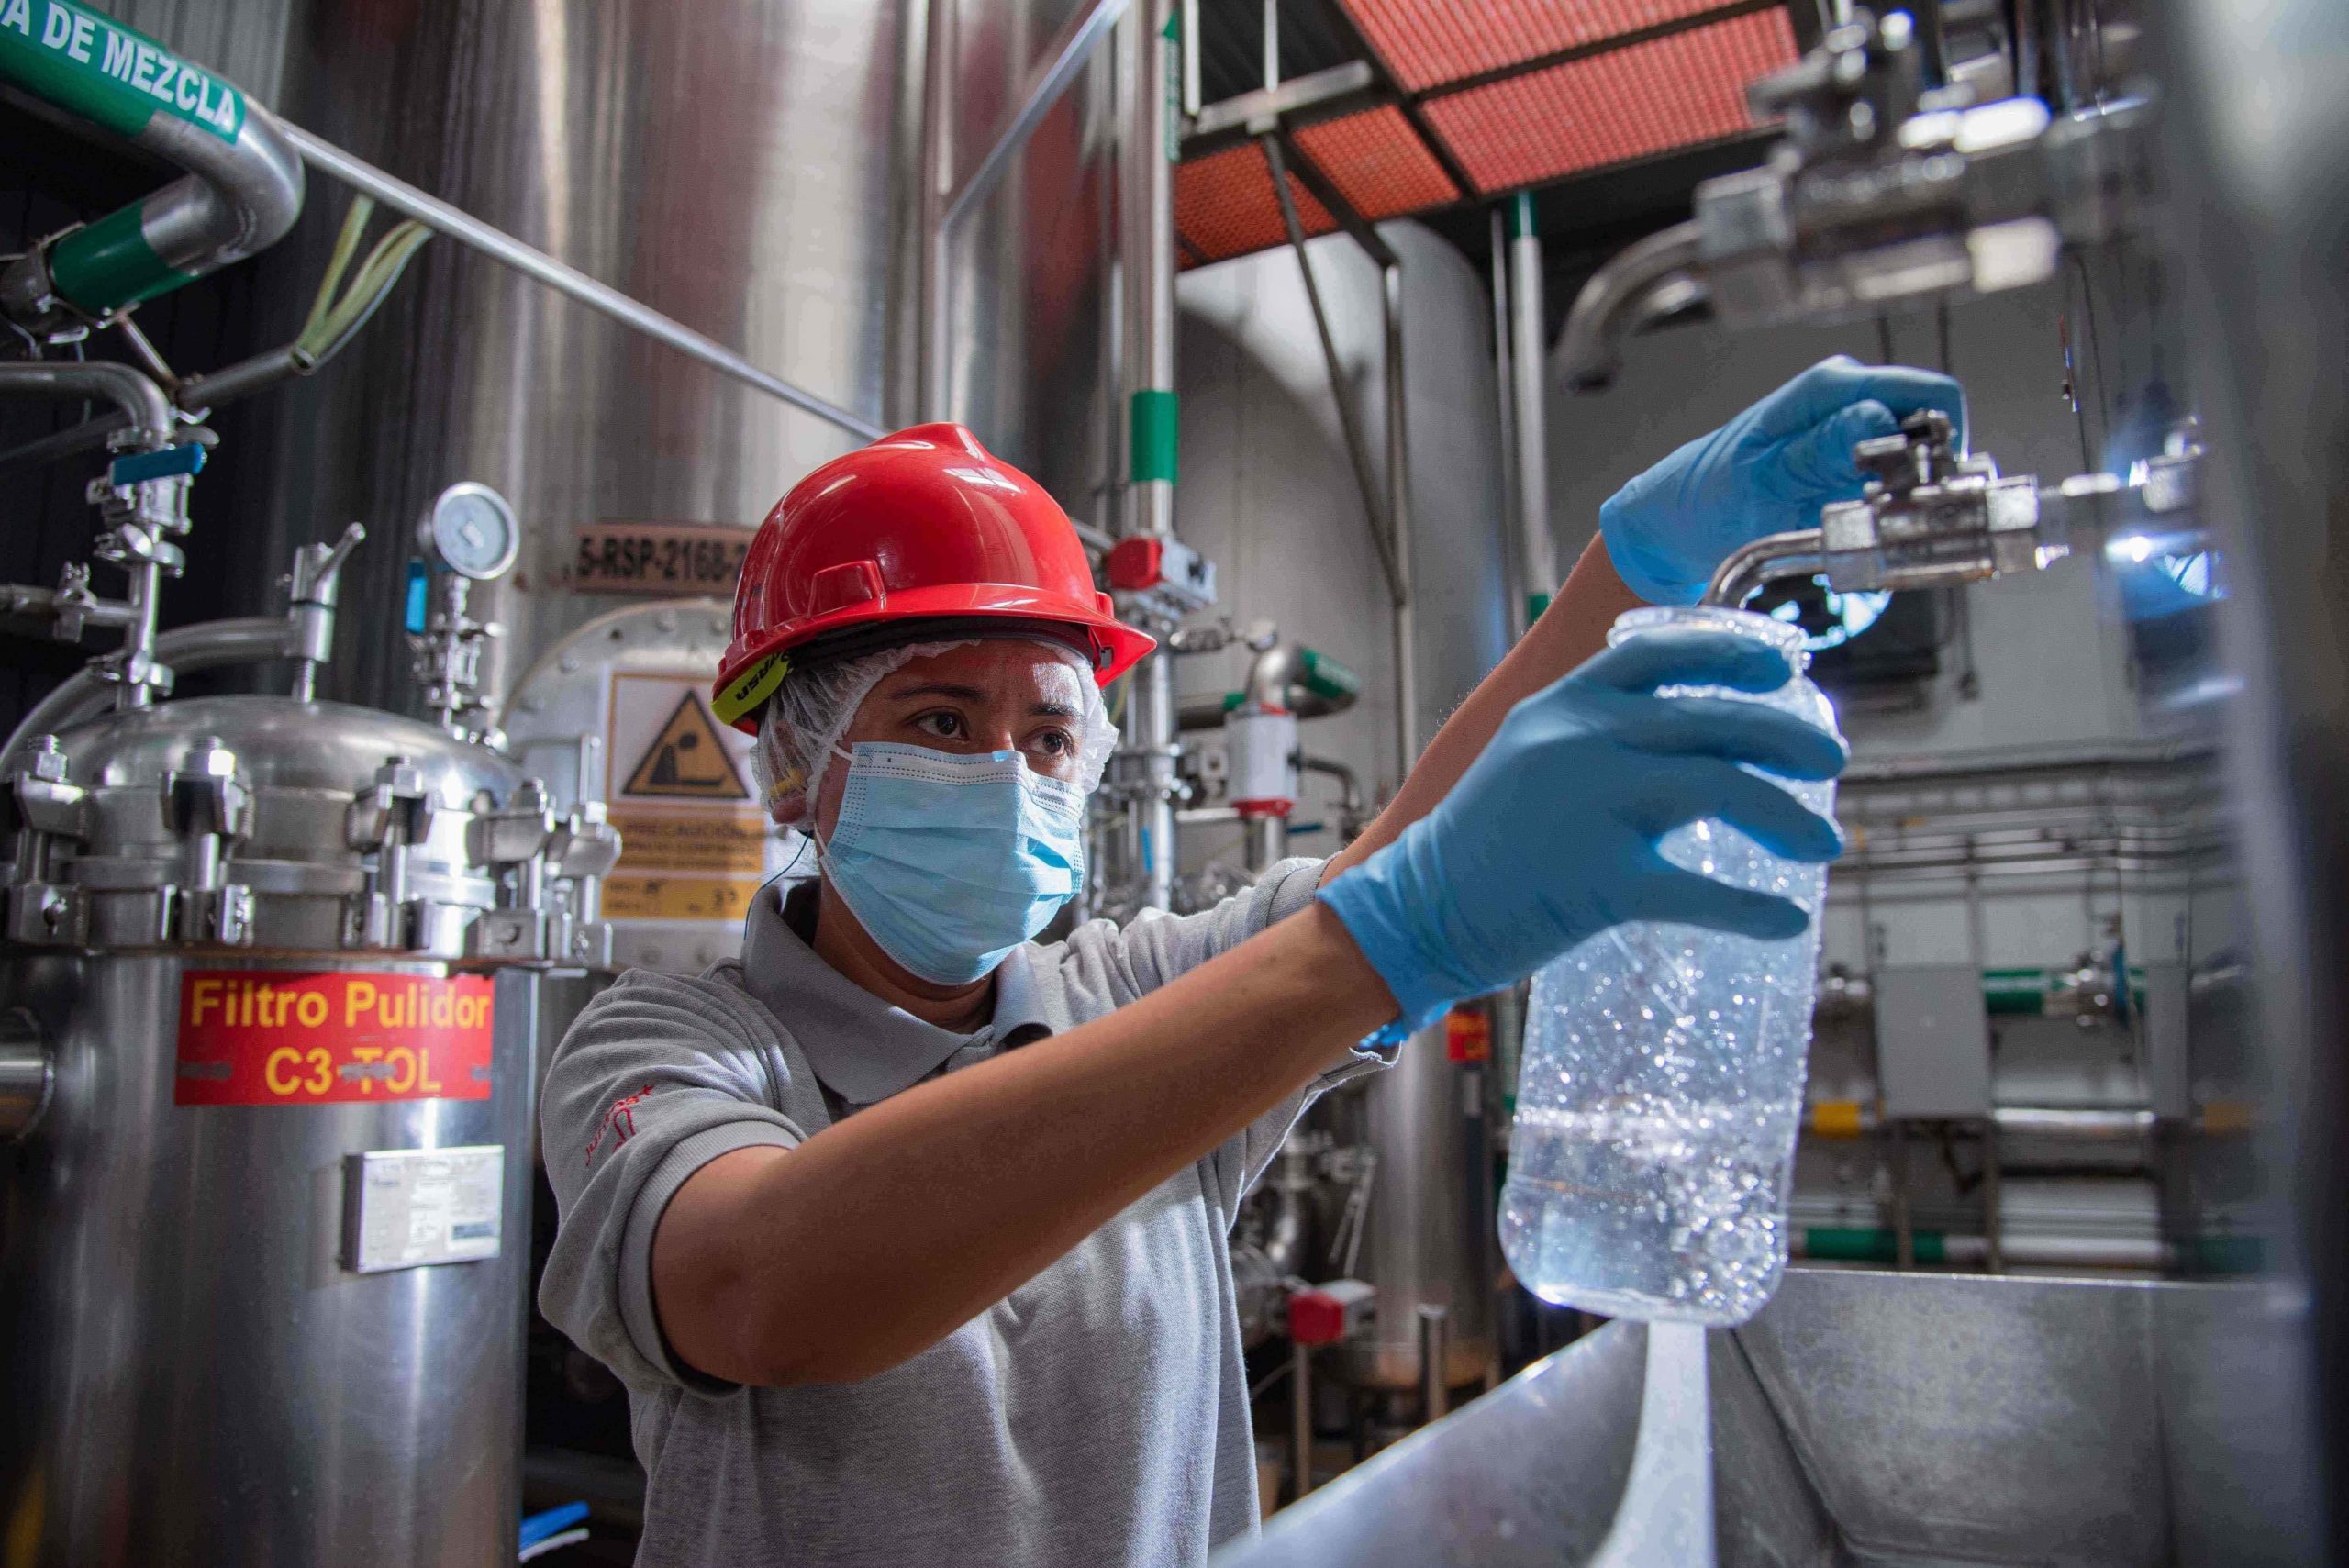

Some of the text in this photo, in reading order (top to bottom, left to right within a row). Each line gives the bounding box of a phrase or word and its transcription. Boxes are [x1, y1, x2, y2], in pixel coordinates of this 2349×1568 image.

[41, 1, 95, 64] DE
[101, 29, 237, 134] MEZCLA
[191, 979, 492, 1029] Filtro Pulidor
